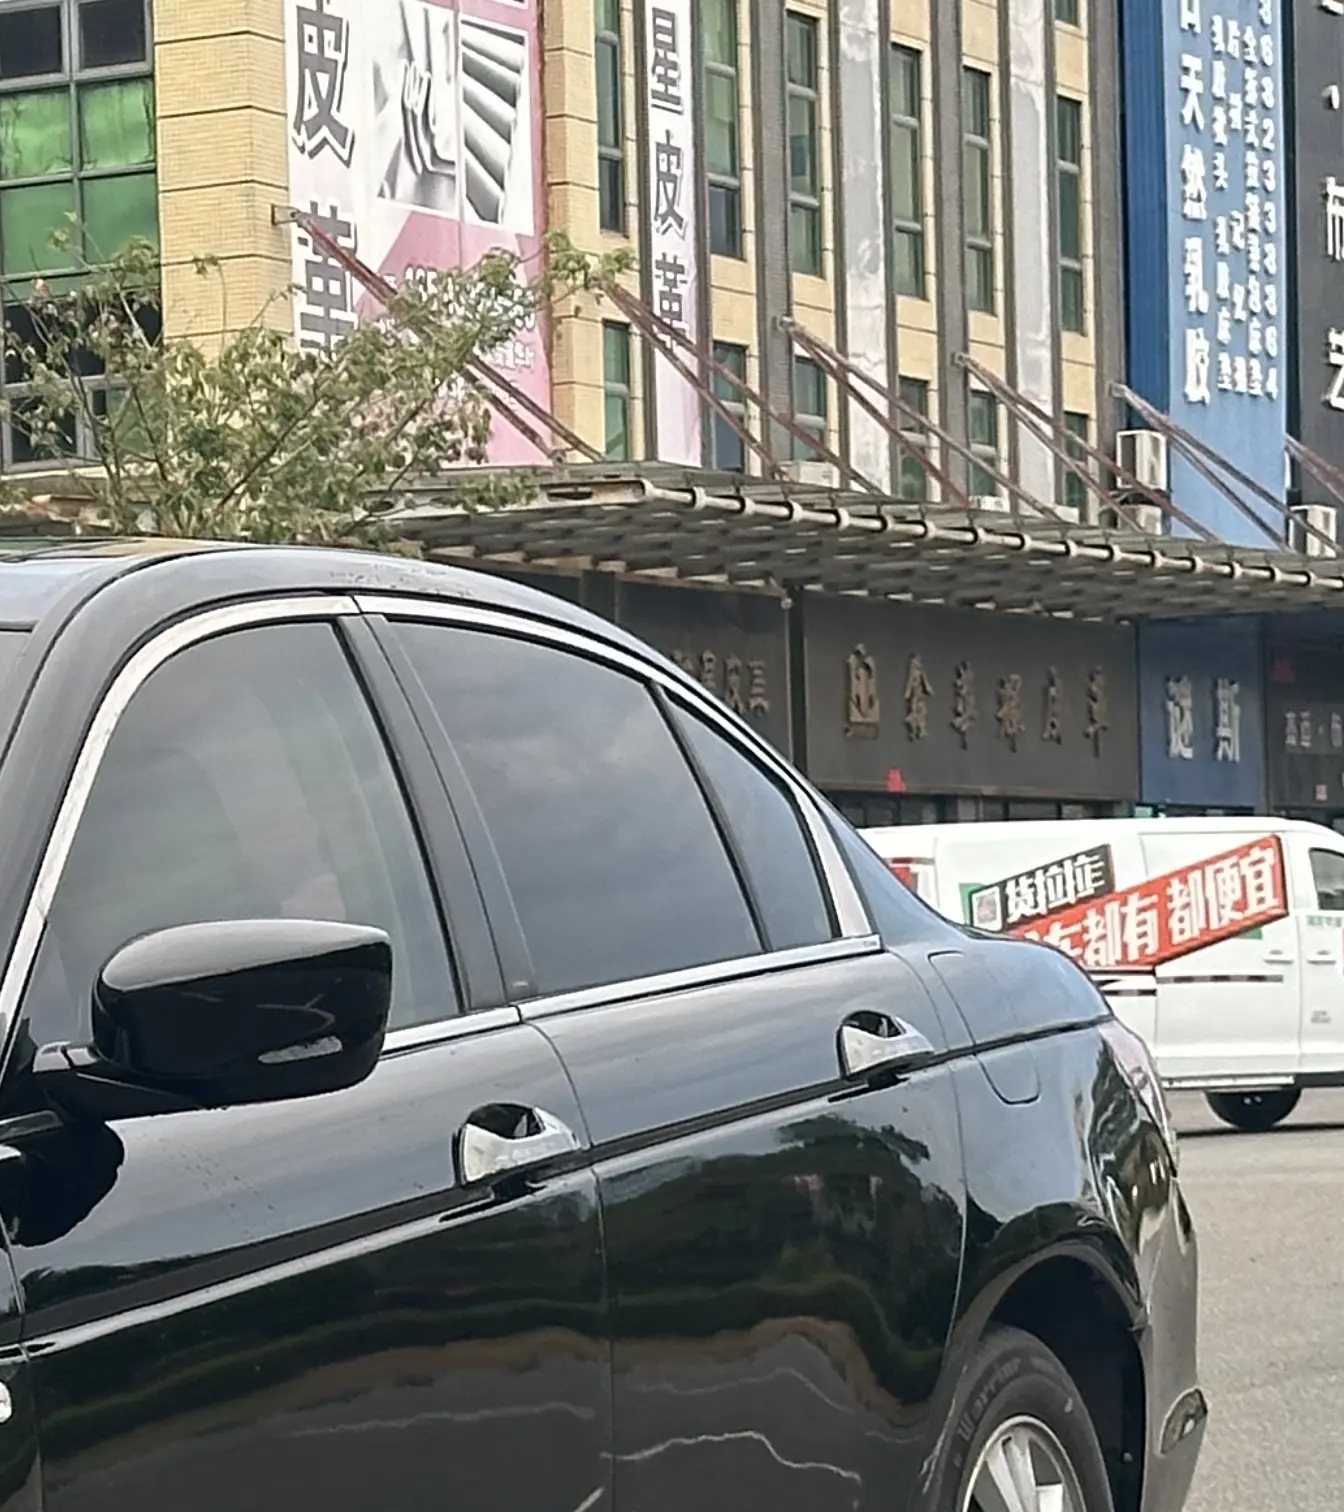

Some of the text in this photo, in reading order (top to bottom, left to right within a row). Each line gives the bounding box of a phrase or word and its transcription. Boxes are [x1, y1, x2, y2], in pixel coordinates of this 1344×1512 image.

[1005, 852, 1105, 923] 货拉拉
[1167, 847, 1278, 946] 都便宜
